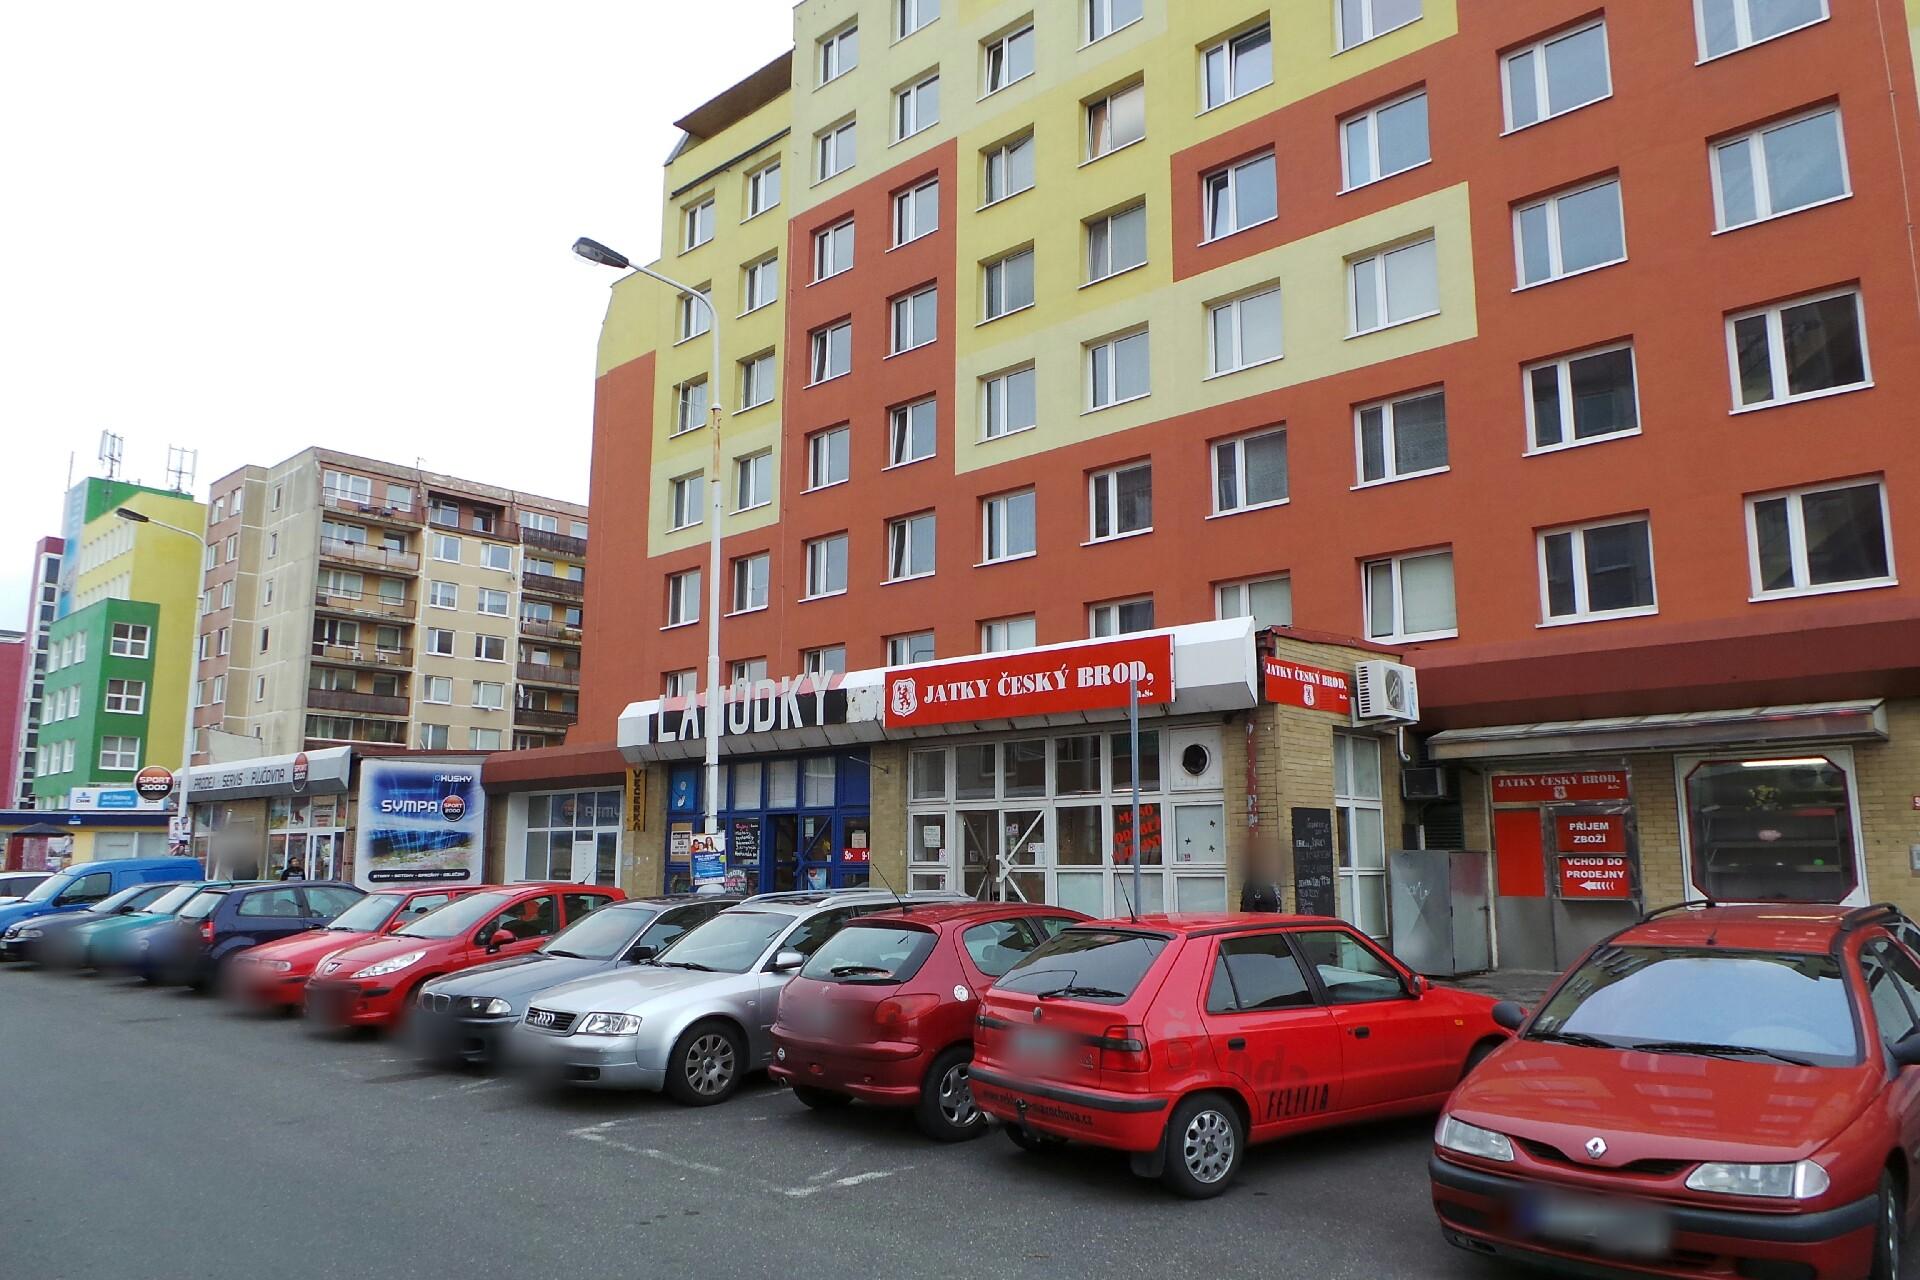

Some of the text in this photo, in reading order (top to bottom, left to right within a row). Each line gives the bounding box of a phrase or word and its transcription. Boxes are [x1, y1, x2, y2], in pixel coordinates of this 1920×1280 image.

[1266, 662, 1293, 679] JATKY
[1294, 666, 1321, 685] ČESKÝ
[923, 677, 992, 705] JATKY
[997, 663, 1069, 697] ČESKÝ
[139, 776, 171, 784] SPORT
[222, 772, 244, 788] SERVIS
[440, 774, 473, 783] HUSKY
[1498, 778, 1537, 788] JATKY
[1540, 774, 1578, 786] ČESKÝ
[381, 799, 438, 813] SYMPA
[1569, 821, 1609, 831] PŘÍJEM
[1573, 834, 1606, 844] ZBOŽÍ
[1566, 858, 1623, 866] VCHOD DO
[1566, 870, 1625, 879] PRODEJNY
